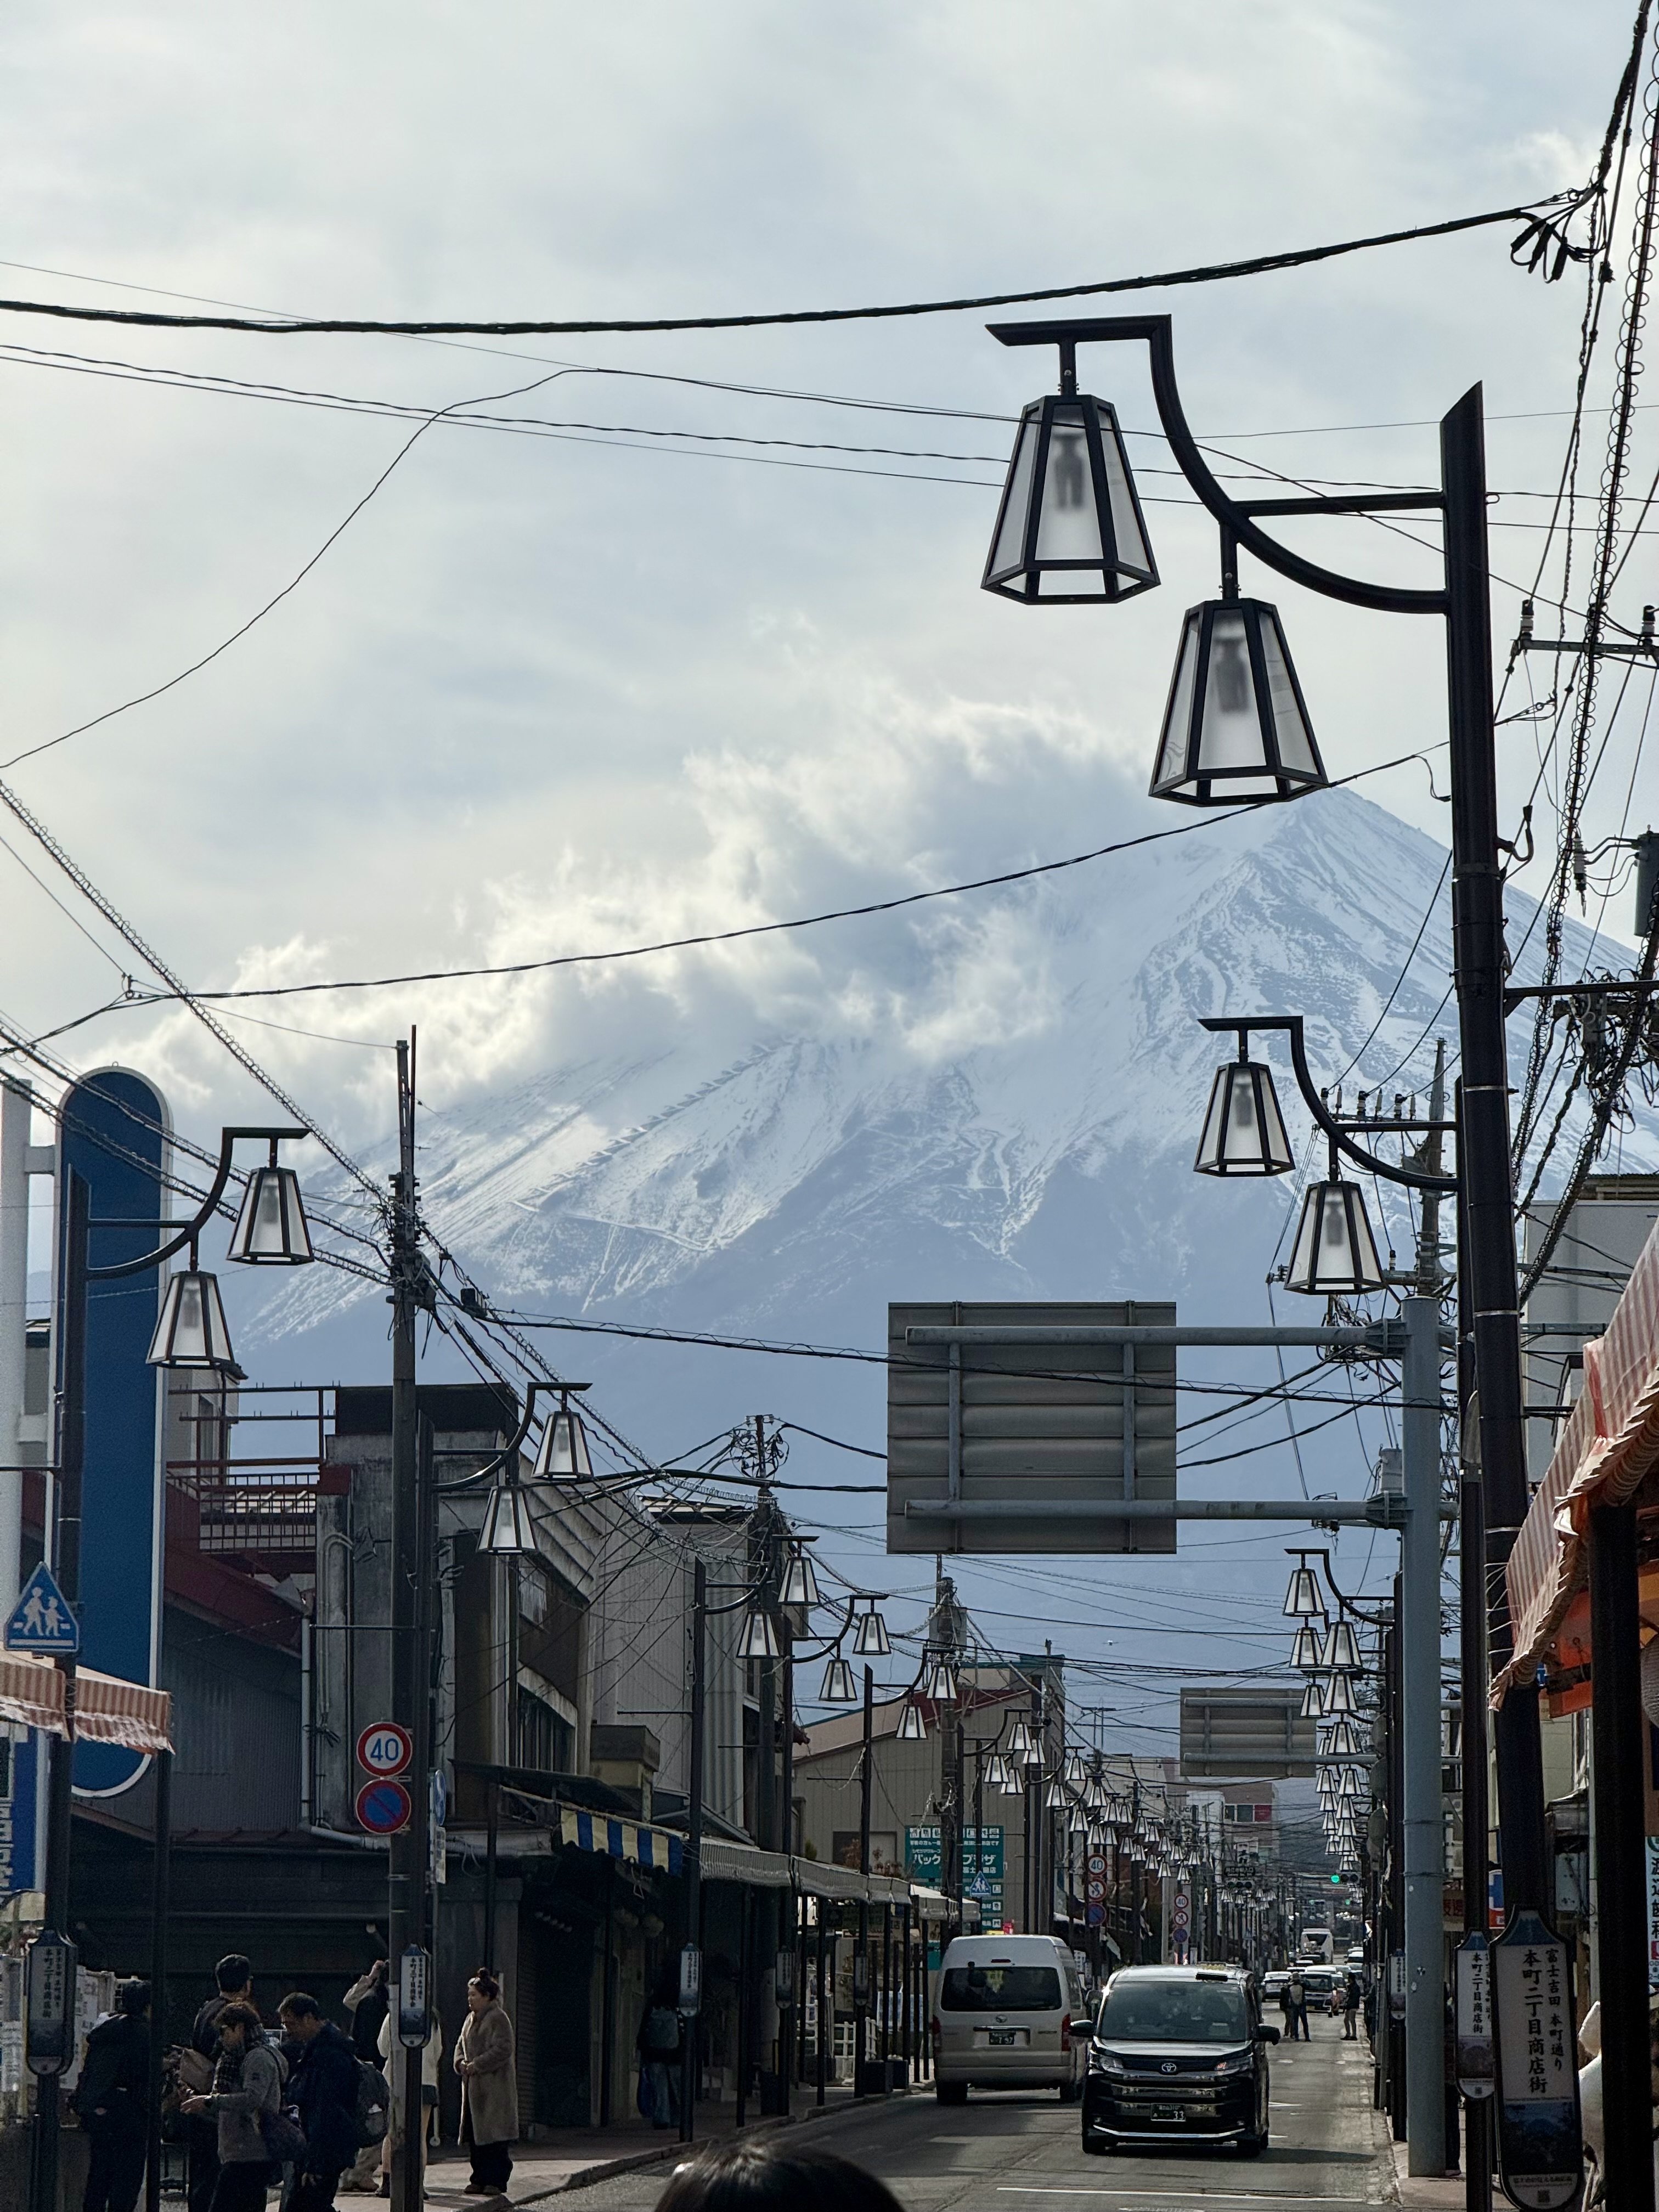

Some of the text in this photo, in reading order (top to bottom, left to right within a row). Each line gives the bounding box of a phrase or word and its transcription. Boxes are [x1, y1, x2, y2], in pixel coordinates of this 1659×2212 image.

[370, 1738, 399, 1761] 40
[1091, 1860, 1103, 1870] 40
[1471, 1952, 1484, 2034] 本町二丁目商店街
[1522, 1949, 1548, 2094] 本町二丁目商店街
[1546, 1948, 1564, 2071] 富士吉田 本町通り
